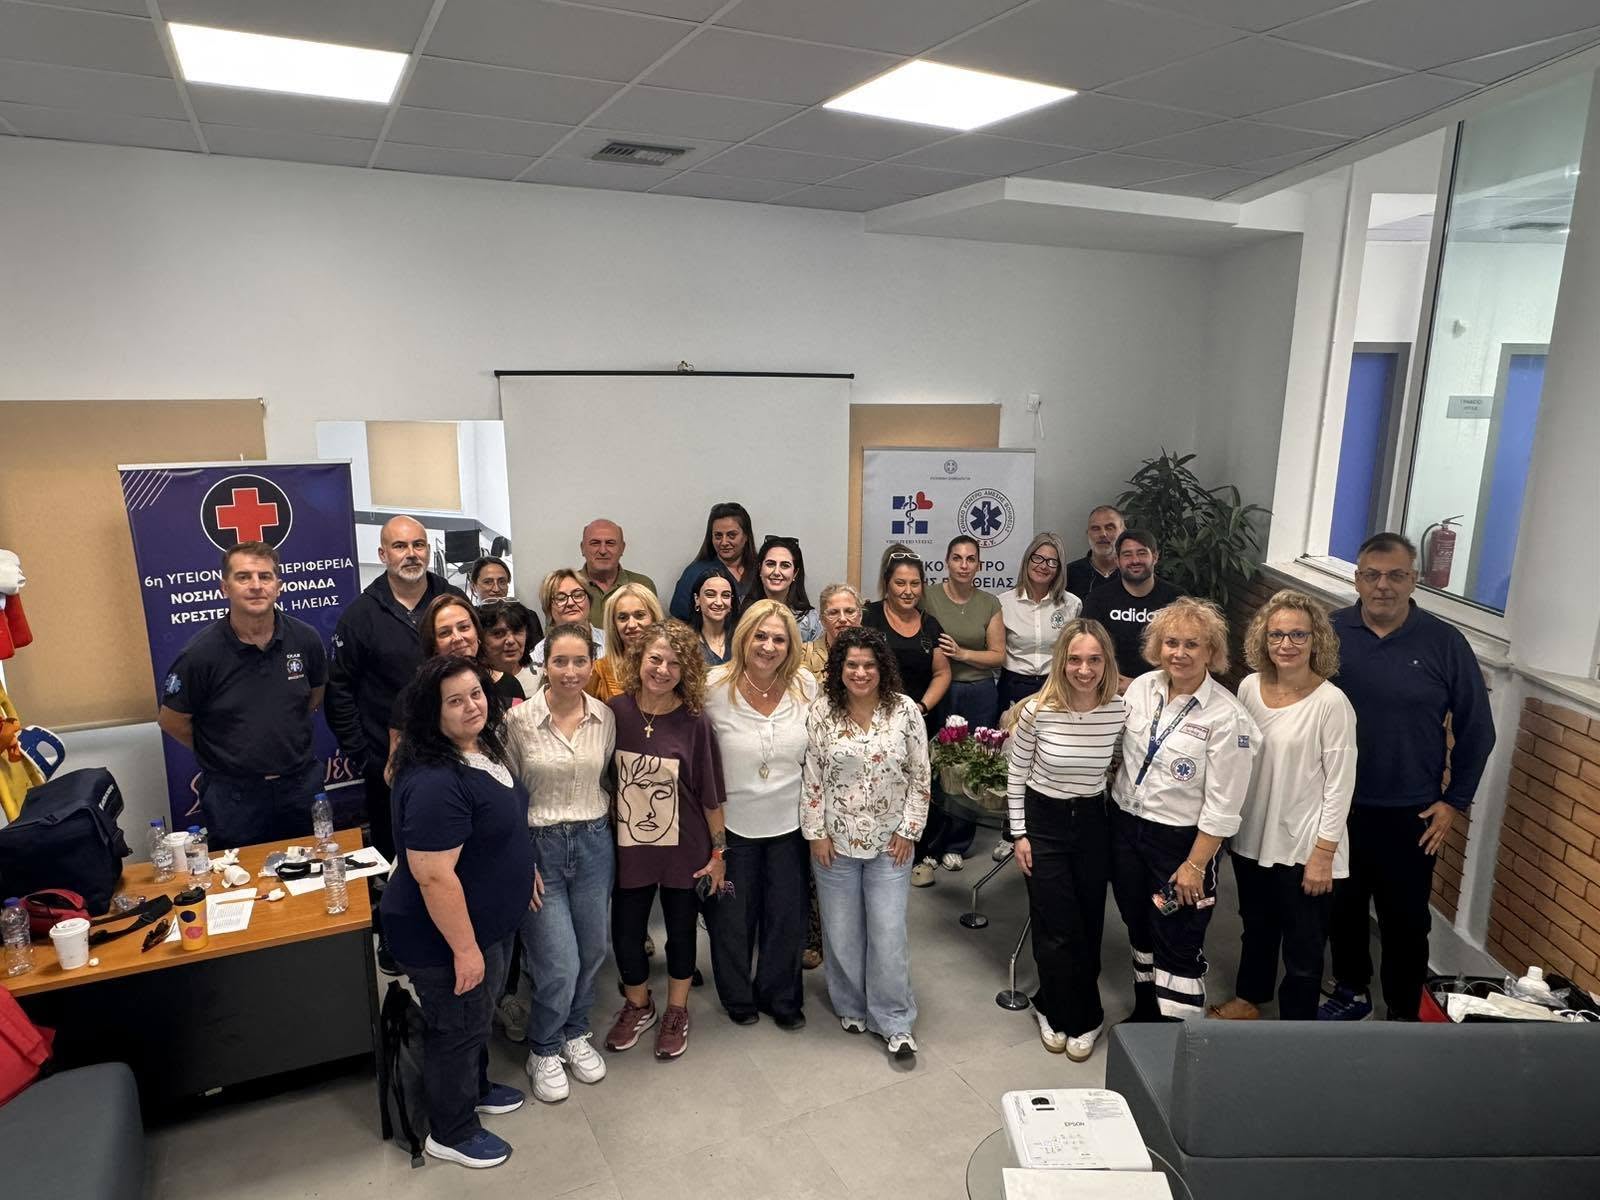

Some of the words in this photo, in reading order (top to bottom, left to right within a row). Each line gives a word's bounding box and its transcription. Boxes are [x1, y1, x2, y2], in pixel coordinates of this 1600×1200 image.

[166, 569, 223, 585] ΥΓΕΙΟΝ
[972, 577, 1014, 588] ΘΕΙΑΣ
[170, 608, 229, 624] ΚΡΕΣΤΕ
[291, 595, 340, 610] ΗΛΕΙΑΣ
